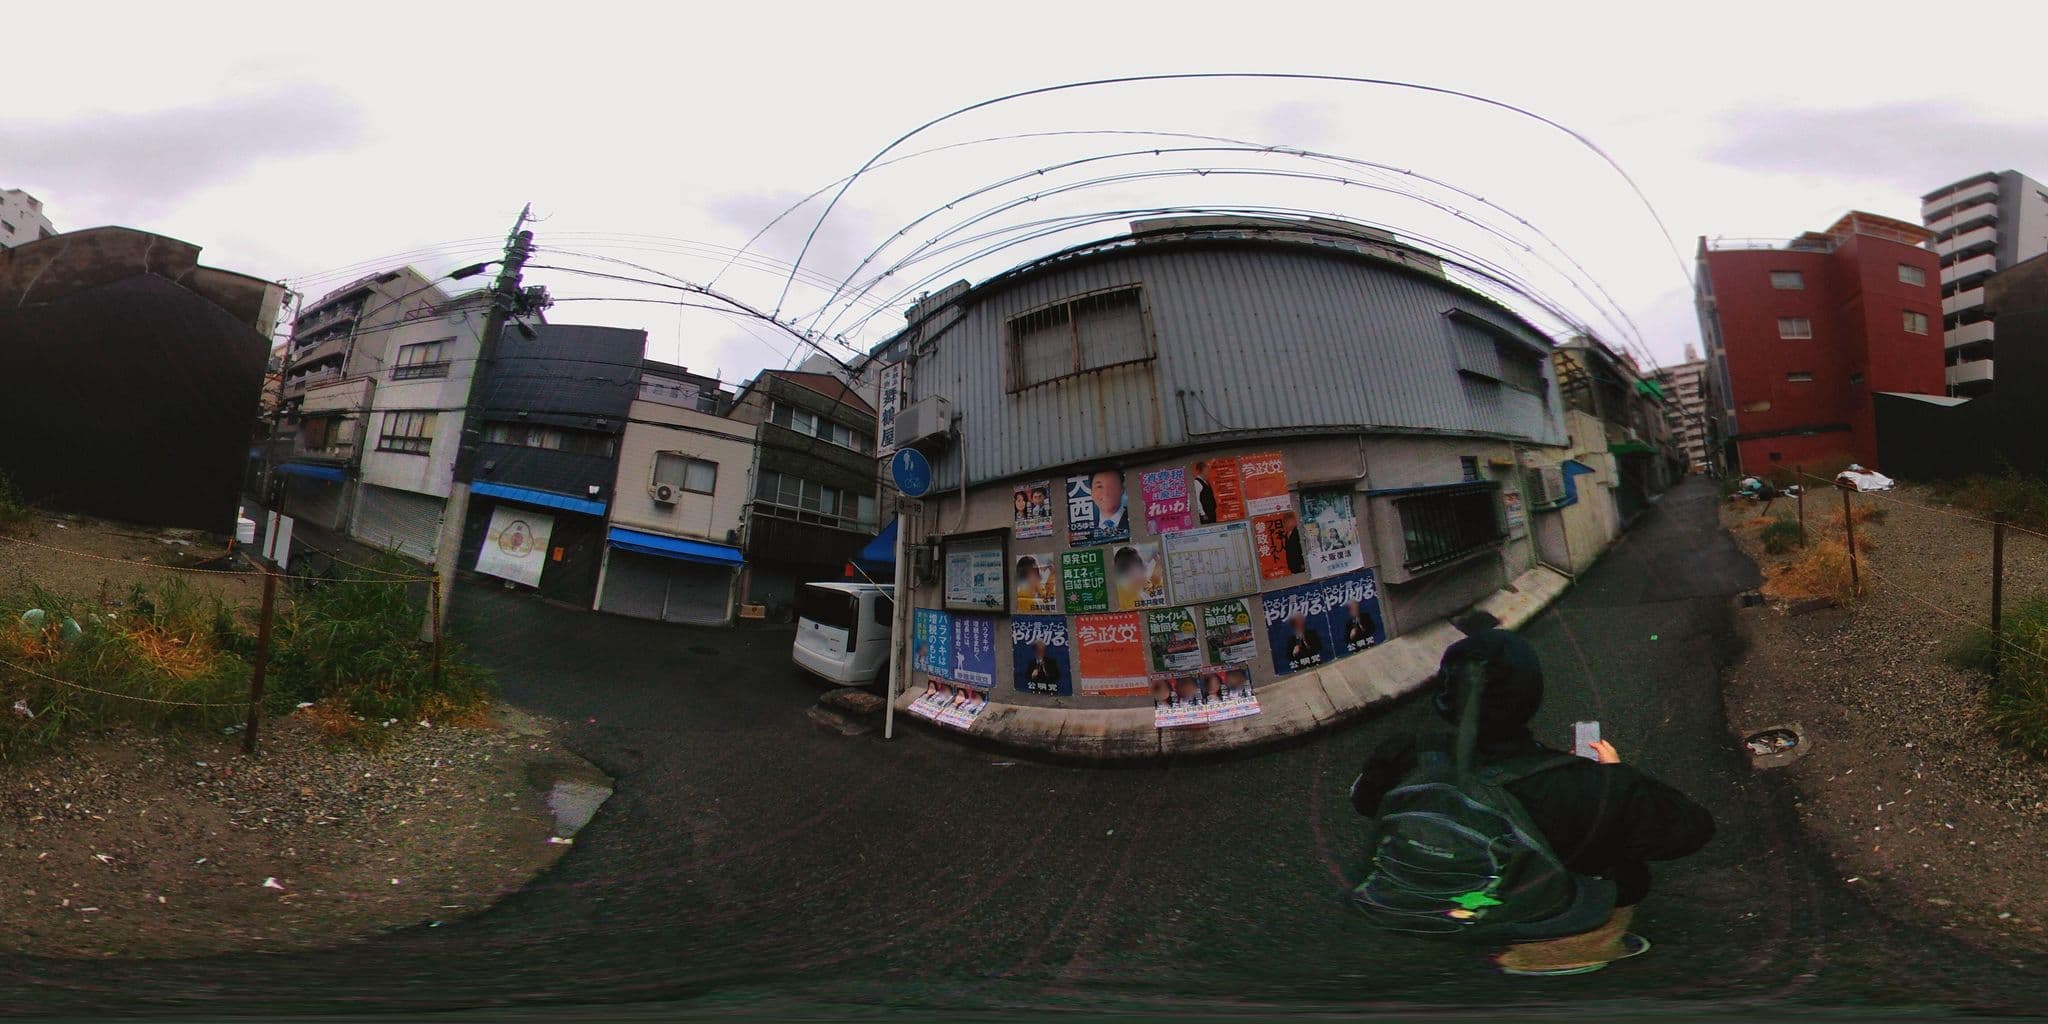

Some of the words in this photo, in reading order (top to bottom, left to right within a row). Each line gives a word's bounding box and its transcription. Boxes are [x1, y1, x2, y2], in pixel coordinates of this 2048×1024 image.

[1241, 460, 1284, 479] 参政党
[1067, 475, 1094, 523] 大西
[1149, 500, 1185, 517] れいわ
[1070, 521, 1095, 531] ひろゆき
[1256, 522, 1271, 557] 参政党
[1063, 553, 1097, 565] 原発ゼロ
[1064, 578, 1104, 590] 自給率UP
[1012, 622, 1068, 632] やると言ったら、
[1079, 624, 1139, 646] 参政党
[928, 613, 938, 664] 増税のもと
[938, 615, 948, 666] バラマキは
[1012, 630, 1069, 646] やり切る。
[1346, 636, 1375, 652] 公明党
[1289, 654, 1321, 669] 公明党
[1027, 681, 1058, 691] 公明党
